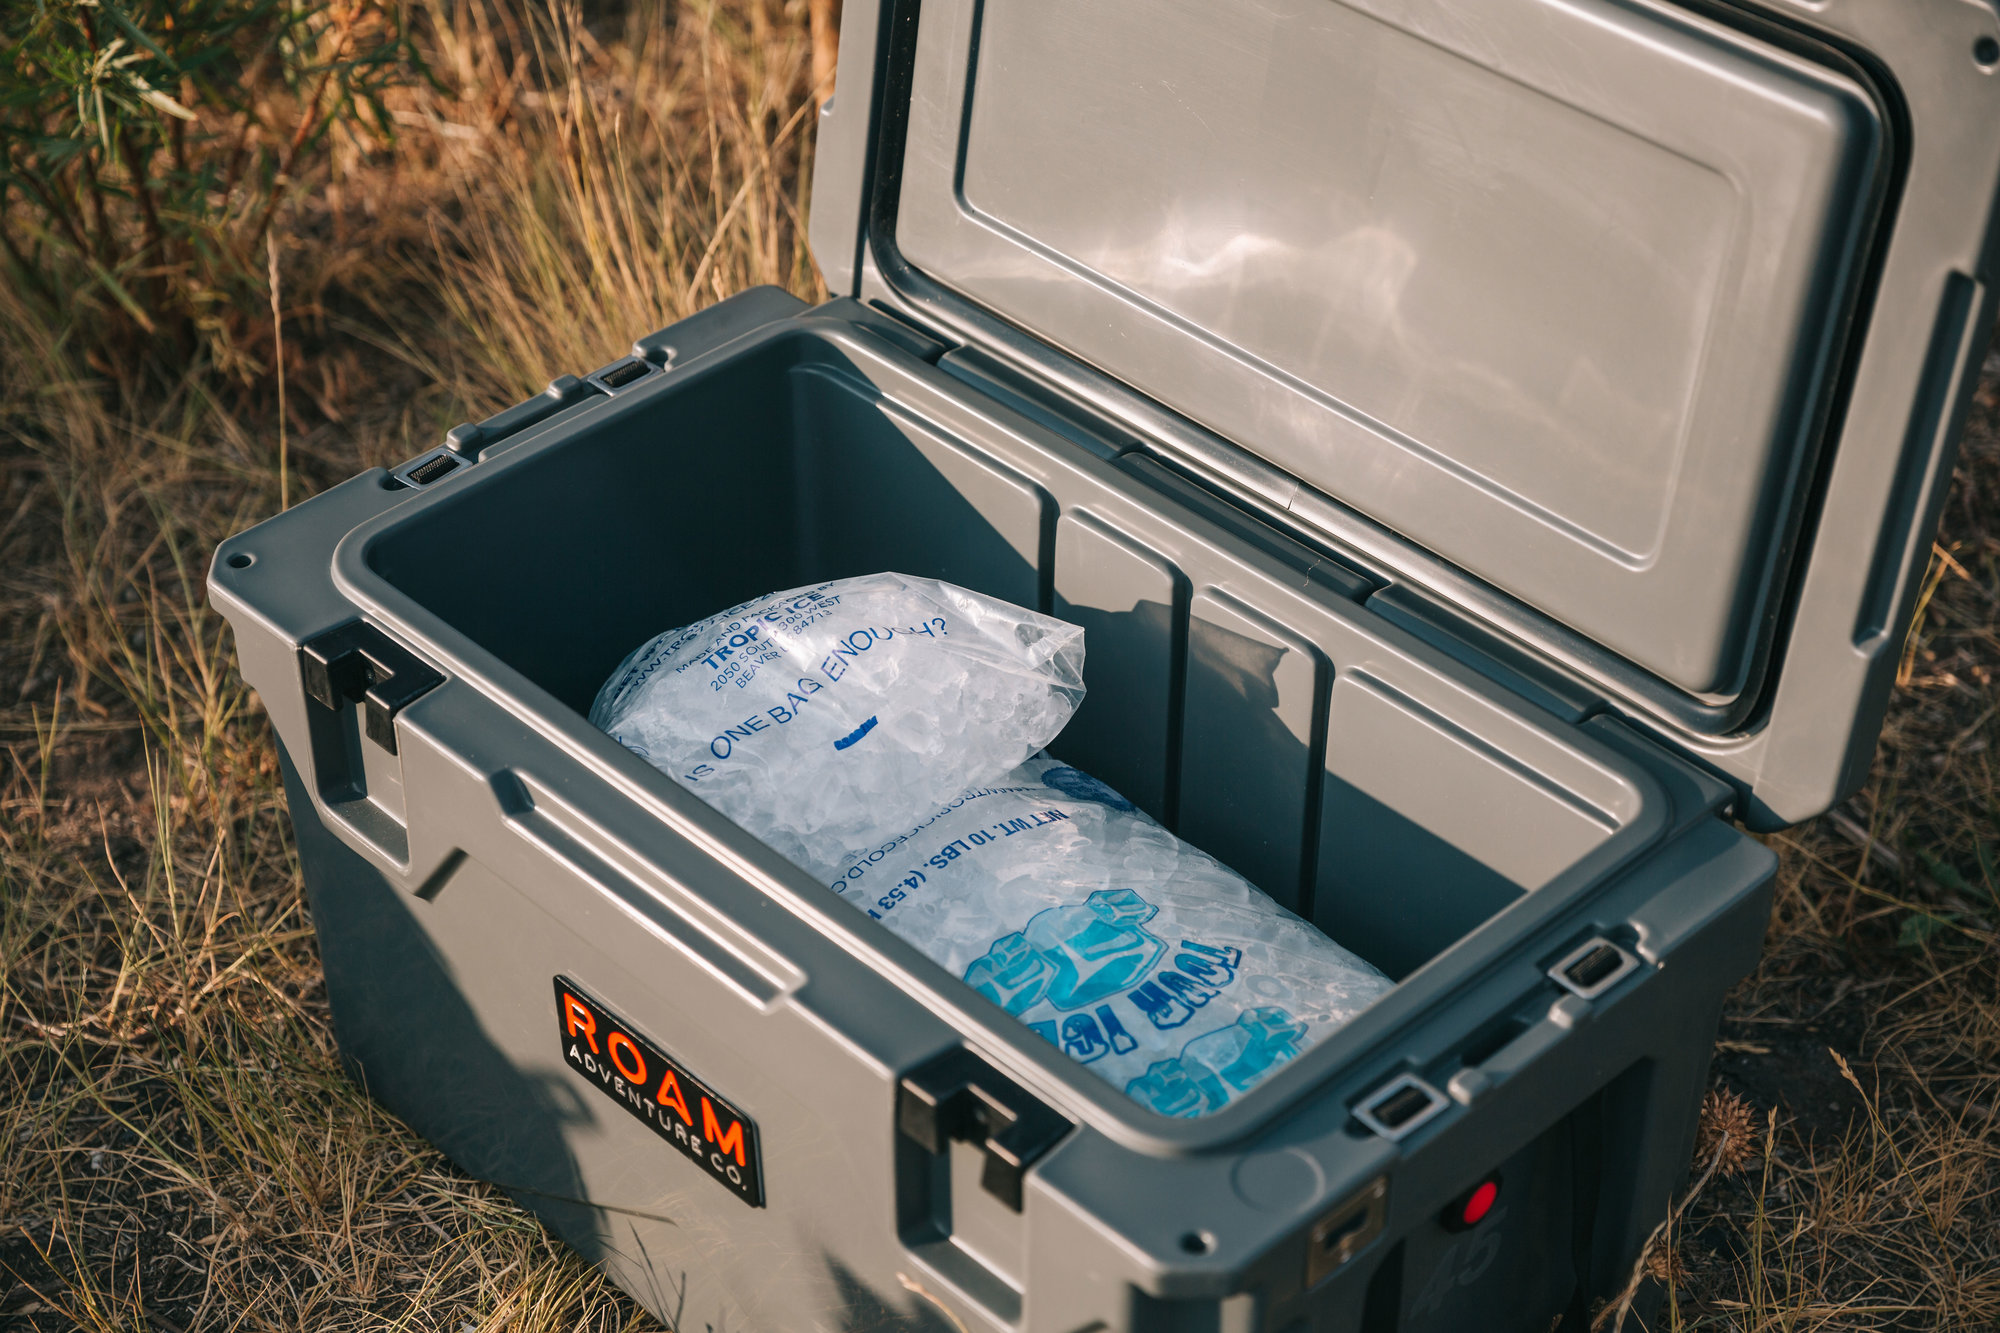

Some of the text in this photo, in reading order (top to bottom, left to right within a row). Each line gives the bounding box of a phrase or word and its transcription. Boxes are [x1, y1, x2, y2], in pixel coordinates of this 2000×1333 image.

[676, 646, 713, 674] MADE
[715, 621, 741, 646] AND
[817, 582, 834, 591] BY
[700, 611, 783, 670] TROPIC
[785, 592, 825, 614] ICE
[710, 661, 741, 692] 2050
[739, 629, 778, 663] SOUT
[778, 613, 803, 631] 300
[804, 595, 841, 615] WEST
[735, 609, 833, 689] BEAVER 84713
[684, 764, 715, 782] IS
[711, 715, 771, 759] ONE
[767, 677, 824, 725] BAG
[923, 839, 972, 870] LBS.
[967, 829, 997, 847] 10
[992, 818, 1035, 837] WT.
[877, 870, 926, 910] (4.53
[563, 992, 746, 1167] ROAM
[569, 1043, 747, 1191] ADVENTURE CO.
